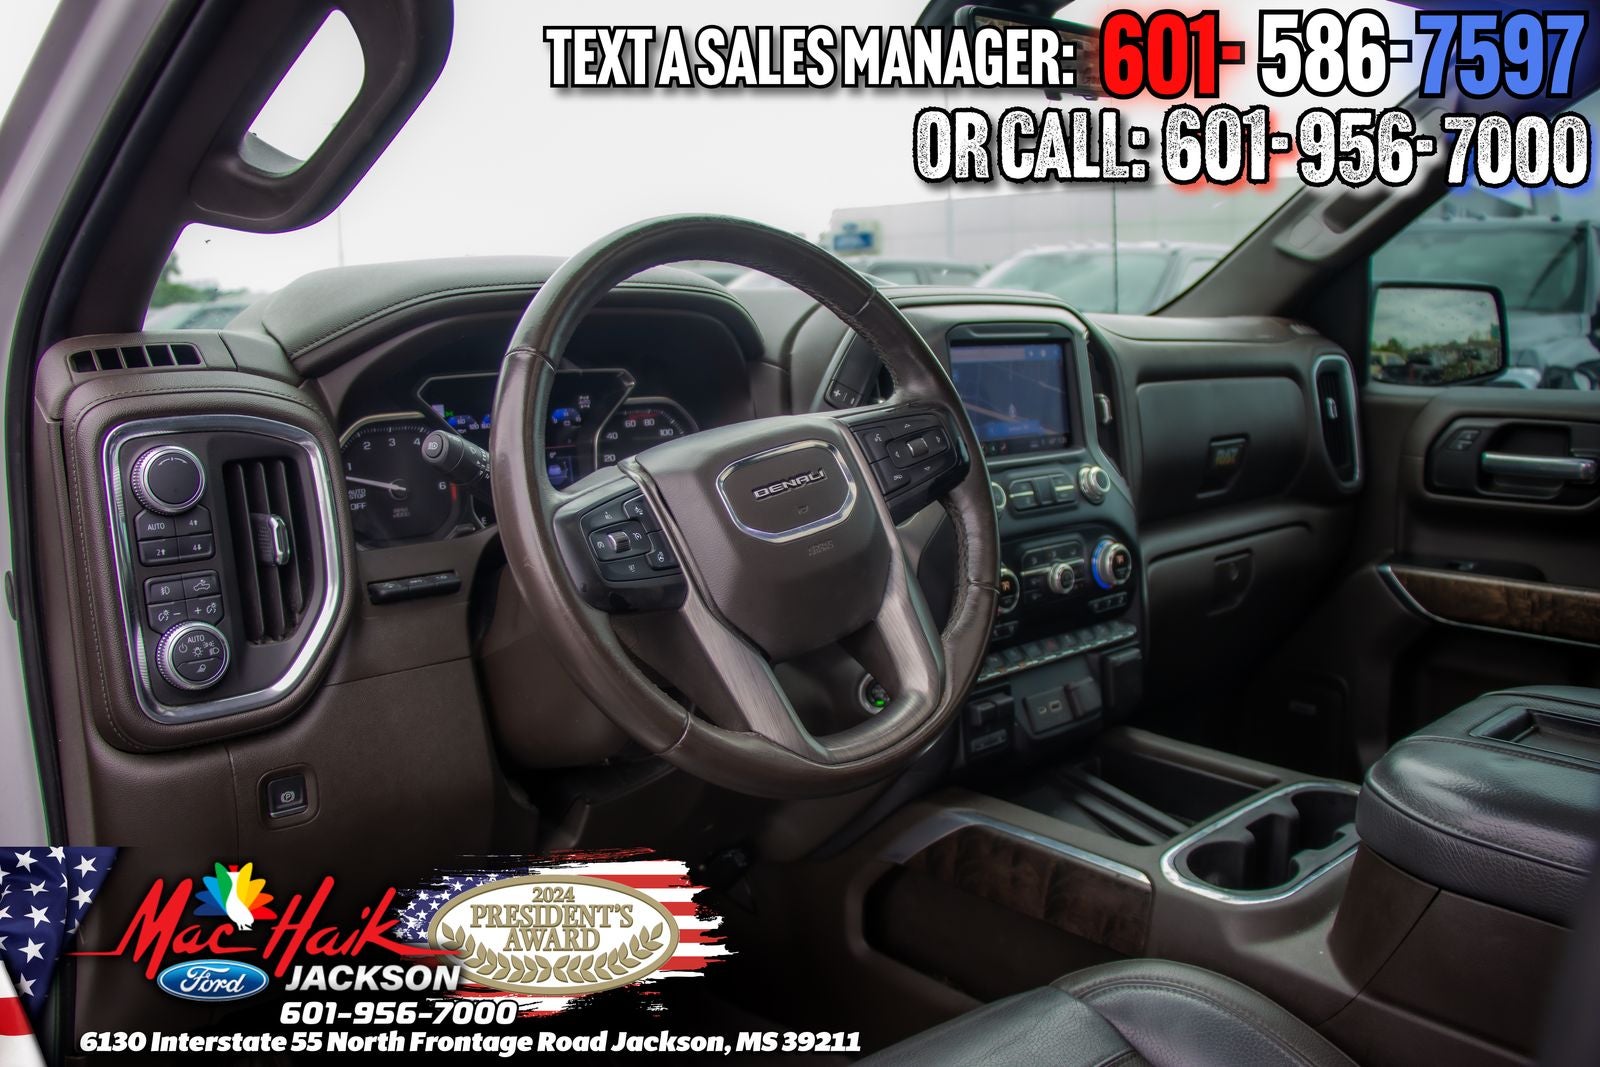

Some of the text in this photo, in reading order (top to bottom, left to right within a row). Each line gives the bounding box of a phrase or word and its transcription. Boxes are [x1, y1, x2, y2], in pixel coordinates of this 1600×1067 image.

[625, 420, 636, 428] 60
[644, 418, 655, 426] 80
[606, 432, 618, 440] 40
[660, 428, 674, 436] 100
[363, 441, 371, 450] 2
[388, 438, 396, 447] 3
[413, 438, 421, 446] 4
[604, 454, 616, 462] 20
[347, 462, 352, 471] 1
[439, 481, 447, 490] 6
[753, 469, 826, 499] DENALI
[350, 502, 366, 510] OFF
[147, 522, 165, 531] AUTO
[187, 634, 205, 643] AUTO
